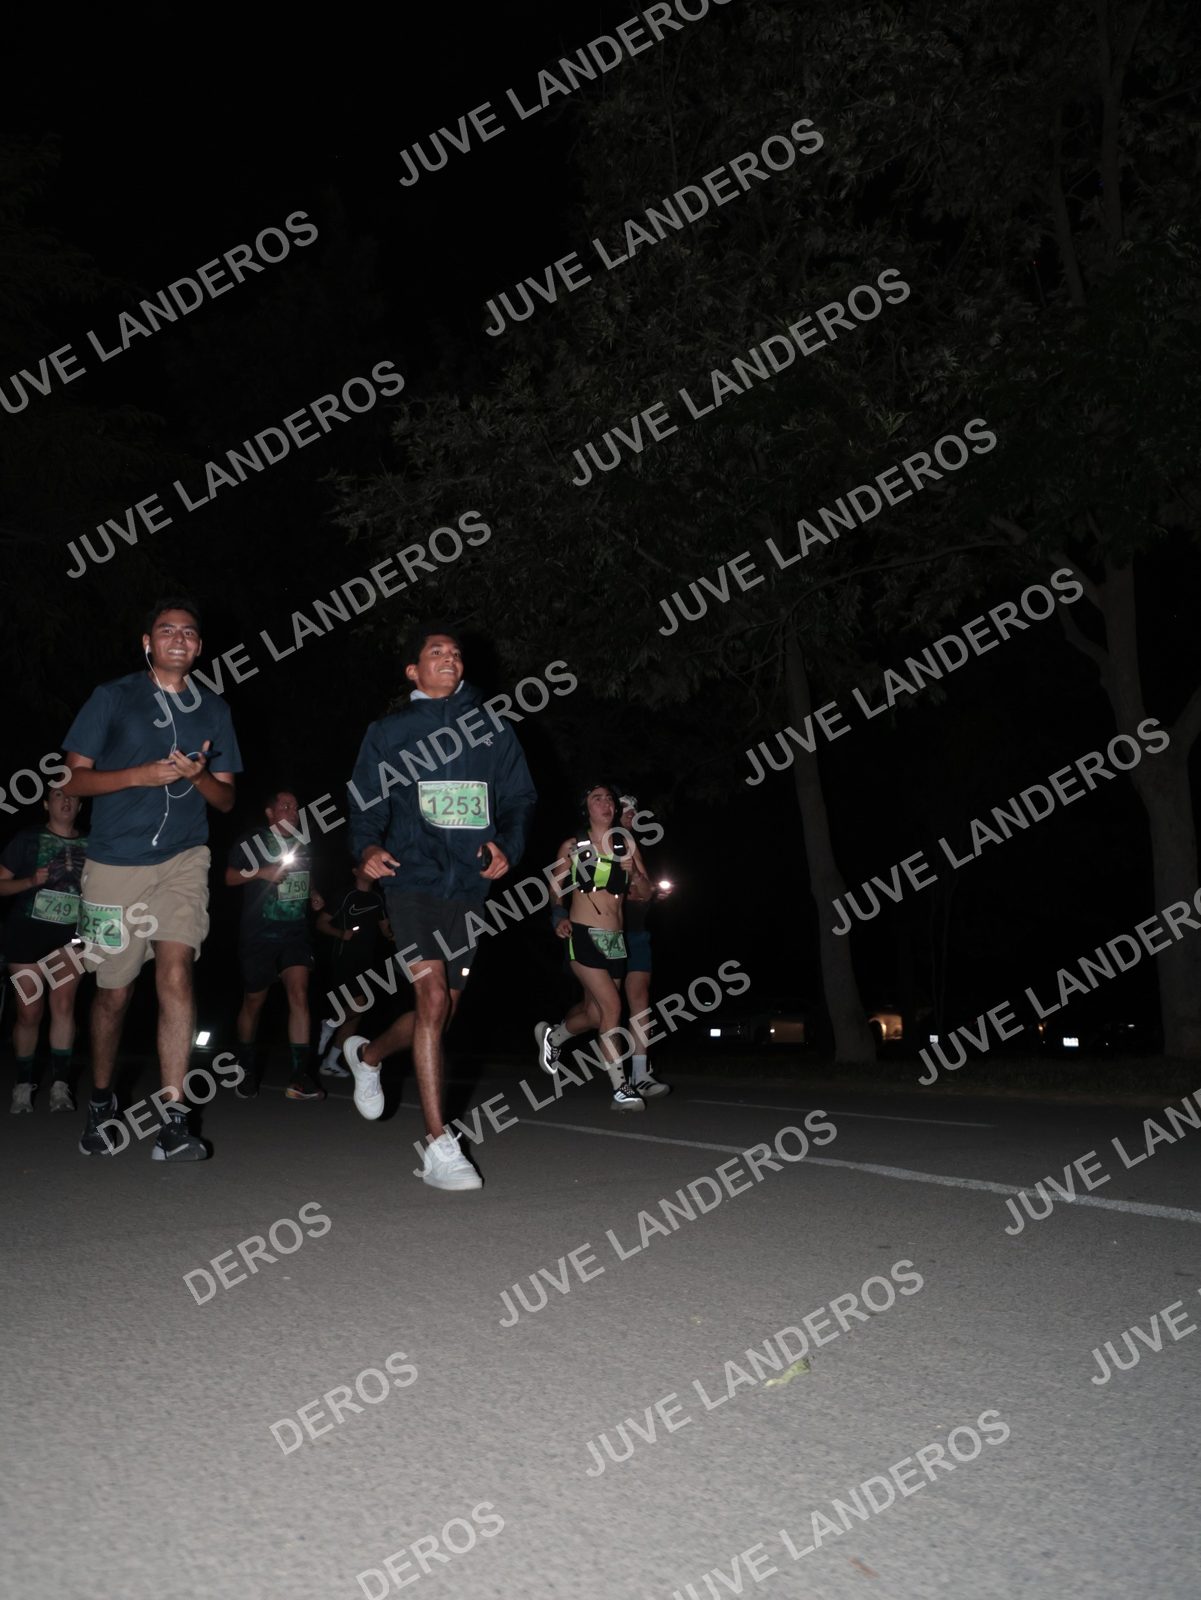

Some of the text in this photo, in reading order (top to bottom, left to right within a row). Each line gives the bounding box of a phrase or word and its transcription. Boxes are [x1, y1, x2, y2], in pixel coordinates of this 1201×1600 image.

[427, 795, 482, 816] 1253
[286, 880, 308, 893] 750
[44, 900, 72, 917] 749
